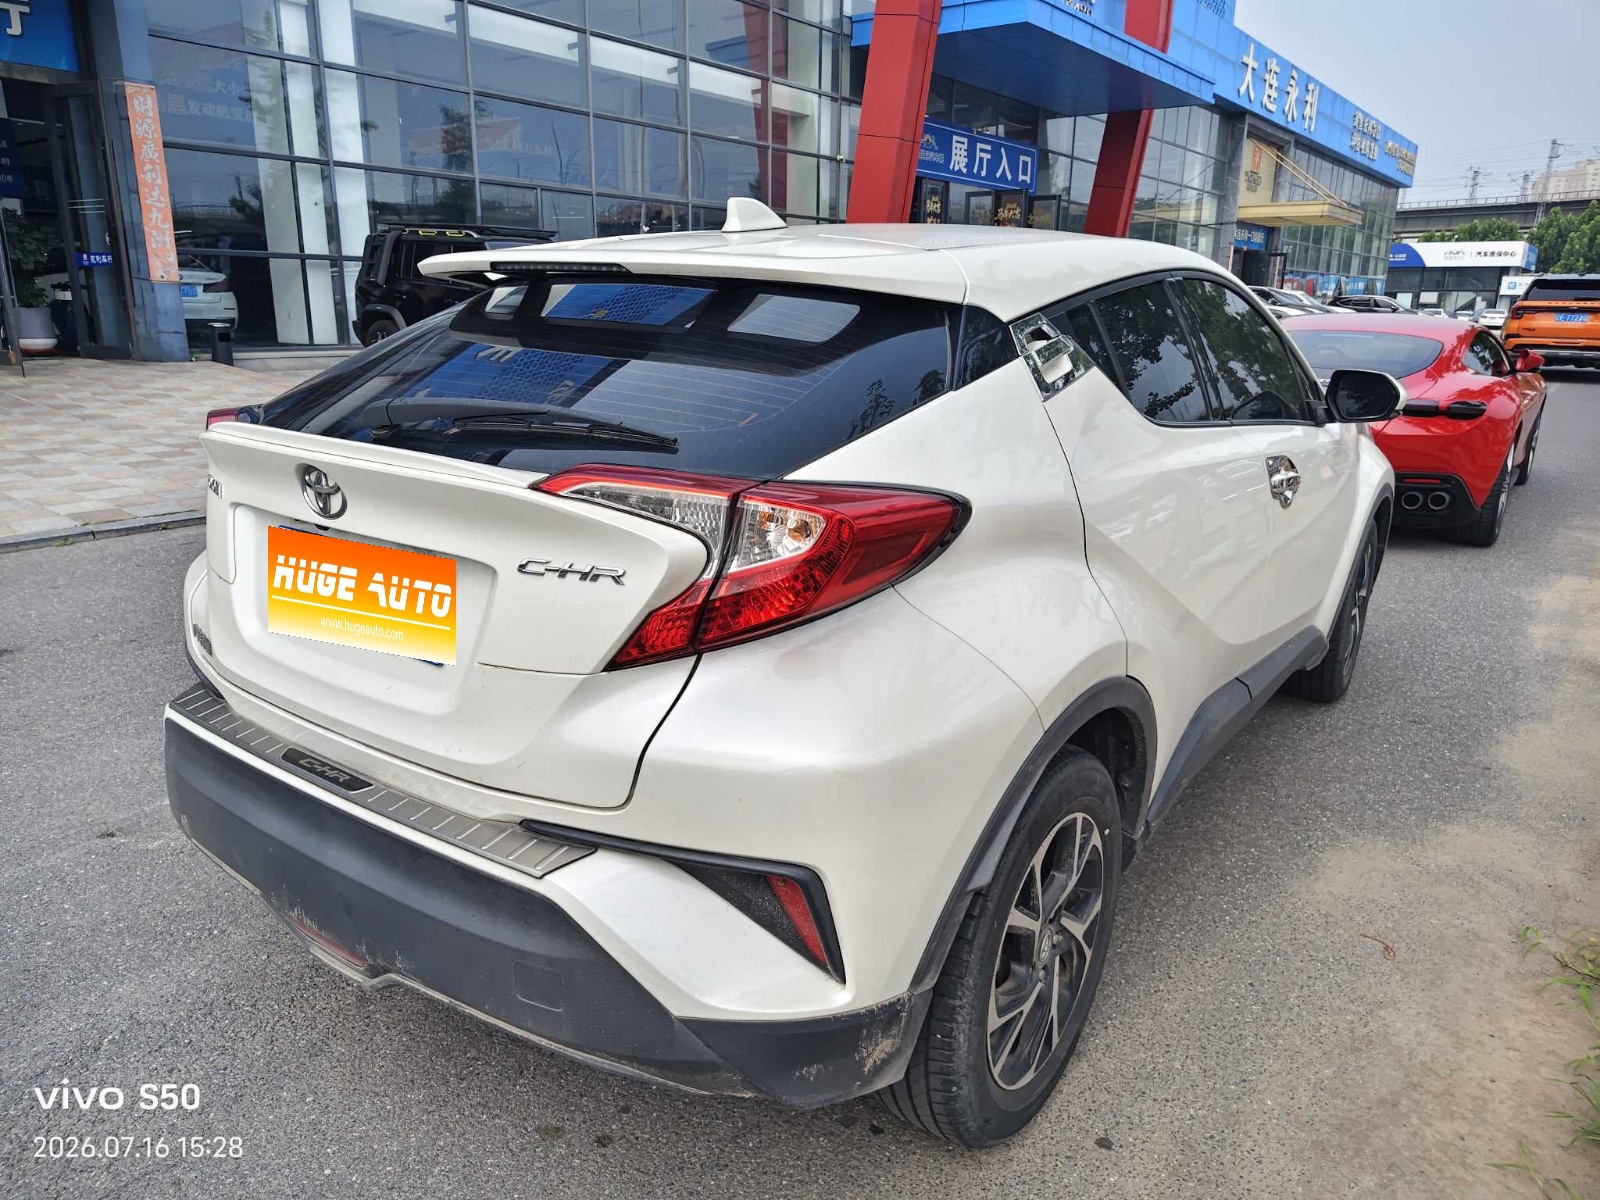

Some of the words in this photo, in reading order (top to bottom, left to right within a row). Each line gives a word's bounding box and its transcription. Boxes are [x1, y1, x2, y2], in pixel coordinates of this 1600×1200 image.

[1239, 43, 1319, 132] 大连永利
[949, 134, 1032, 184] 展厅入口
[517, 558, 626, 586] C-HR
[299, 758, 350, 782] C-HR
